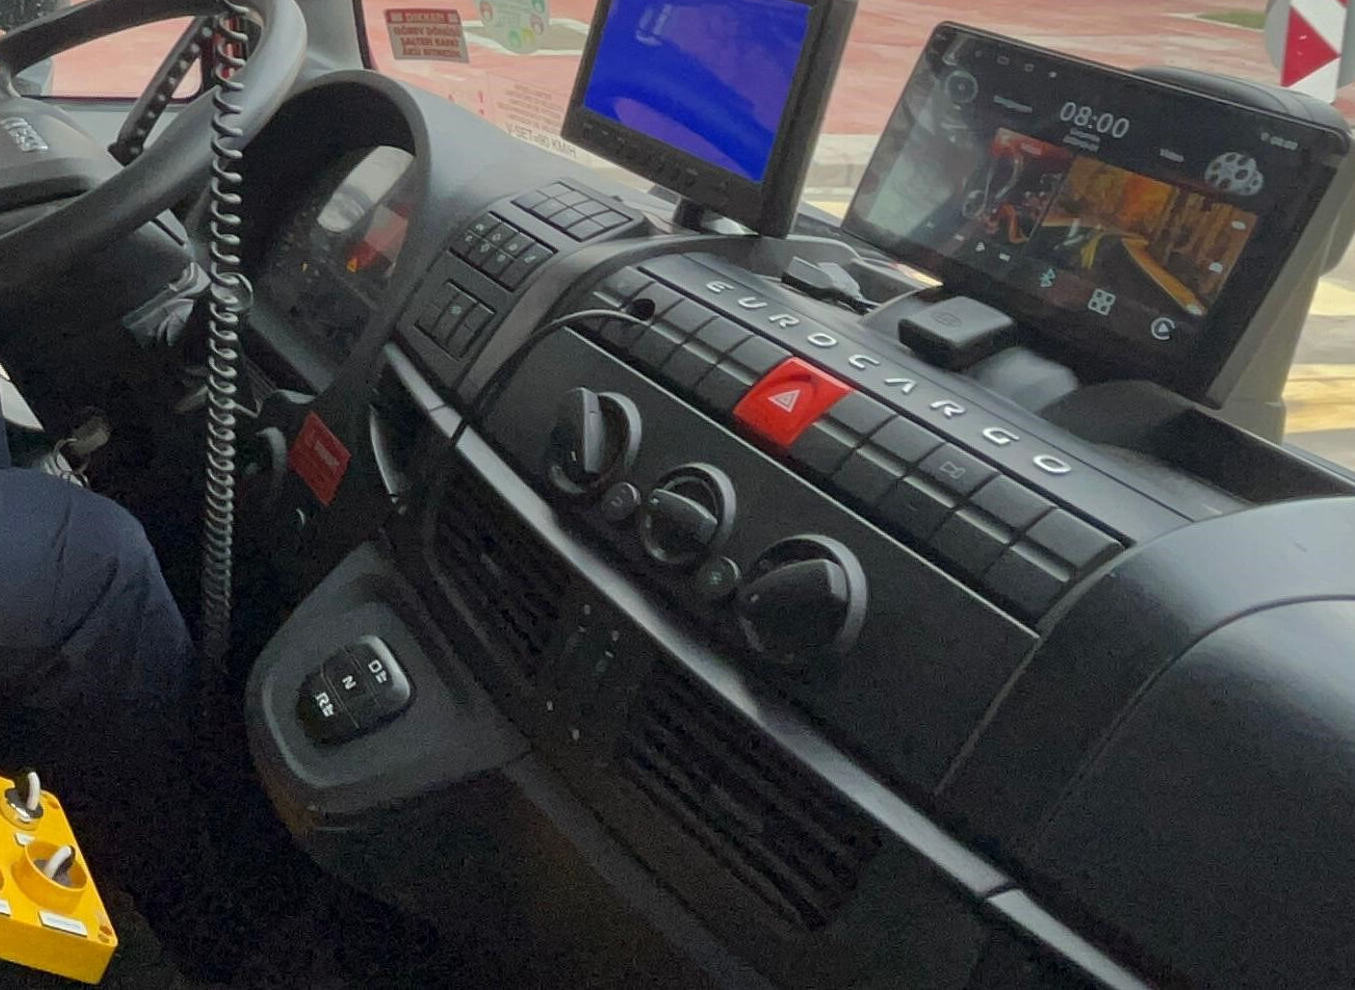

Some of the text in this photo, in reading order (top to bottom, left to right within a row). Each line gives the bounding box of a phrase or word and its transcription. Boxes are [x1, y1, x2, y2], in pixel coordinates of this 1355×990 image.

[1059, 101, 1130, 139] 08:00
[706, 280, 1073, 476] EUROCARGO
[341, 674, 357, 691] N
